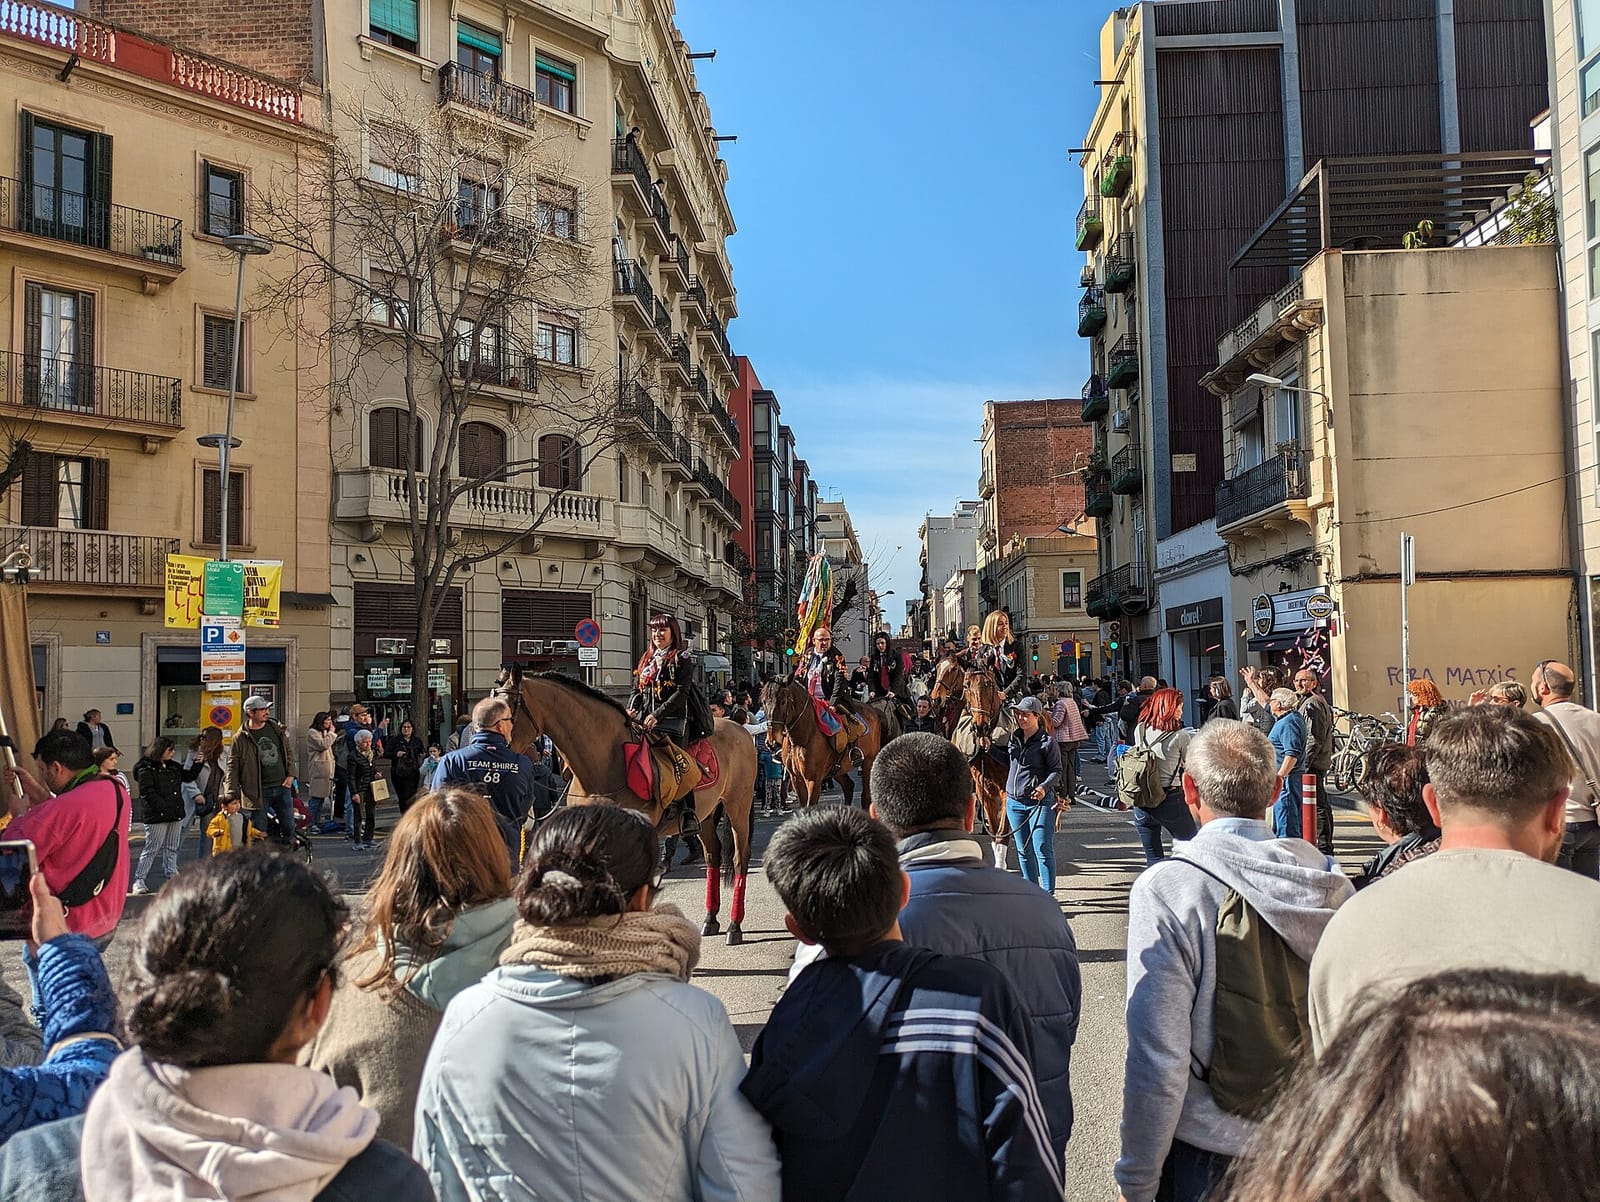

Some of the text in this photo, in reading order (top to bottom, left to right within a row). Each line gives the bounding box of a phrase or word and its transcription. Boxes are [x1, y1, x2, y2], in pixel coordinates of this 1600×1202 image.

[207, 628, 219, 643] P
[467, 760, 519, 770] TEAM SHIRES
[483, 772, 501, 784] 68
